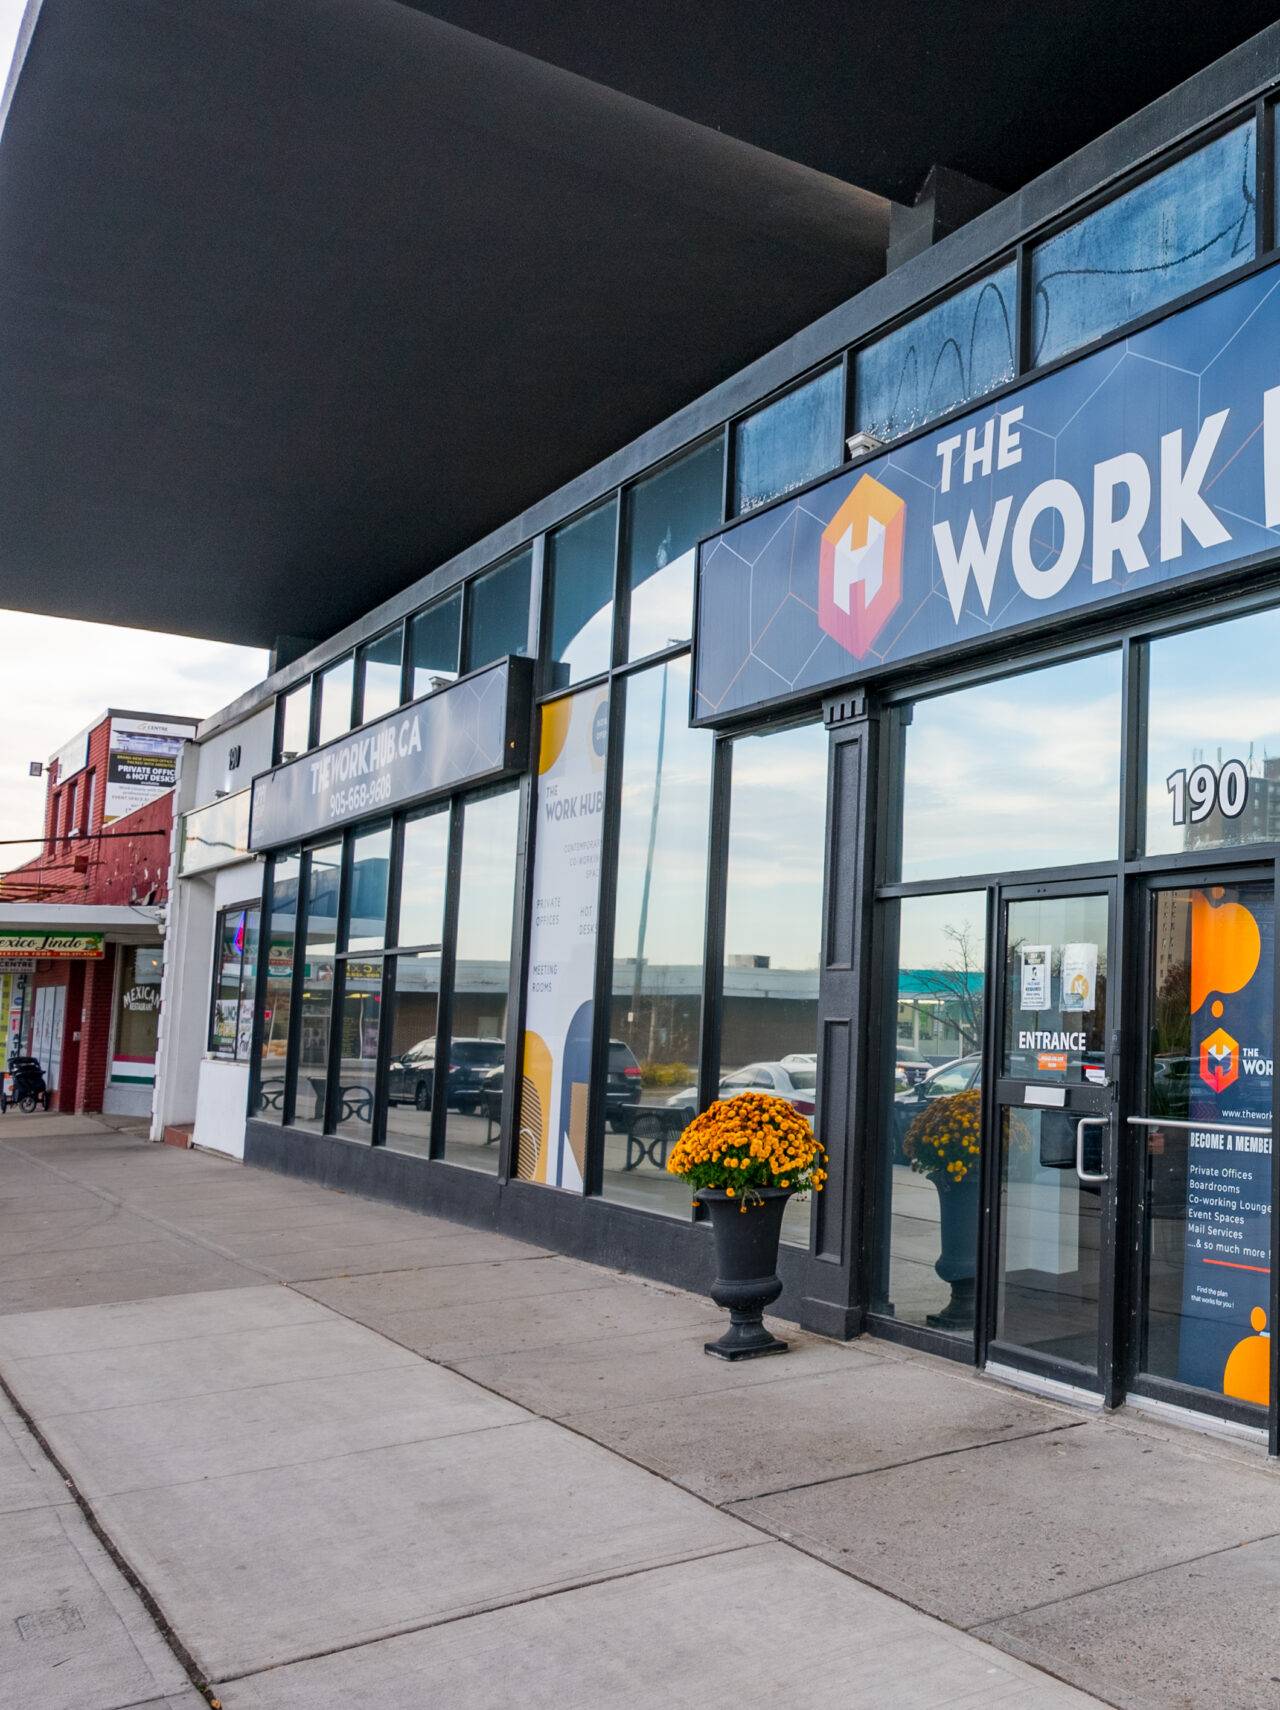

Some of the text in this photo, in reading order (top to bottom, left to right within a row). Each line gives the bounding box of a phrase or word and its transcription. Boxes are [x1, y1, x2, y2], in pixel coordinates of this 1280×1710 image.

[935, 405, 1025, 494] THE
[933, 408, 1233, 626] WORK
[118, 765, 176, 776] PRIVATE OFFIC
[132, 773, 150, 781] HOT
[150, 774, 175, 783] DESKS
[329, 776, 391, 817] 905-668-9608
[546, 785, 558, 798] THE
[1166, 759, 1249, 826] 190
[545, 790, 604, 821] WORK HUB
[586, 868, 600, 879] SPAC
[537, 897, 561, 909] PRIVATE
[580, 906, 592, 917] HOT
[536, 915, 560, 926] OFFICES
[0, 934, 82, 950] exico Lindo
[533, 964, 558, 976] MEETING
[532, 982, 552, 993] ROOMS
[123, 985, 161, 1009] MEXICAN
[1018, 1030, 1087, 1051] ENTRANCE
[1242, 1047, 1259, 1057] THE
[1242, 1059, 1273, 1076] WOR
[1190, 1132, 1225, 1150] BECOME
[1226, 1134, 1233, 1151] A
[1190, 1165, 1253, 1180] Private Offices
[1189, 1179, 1240, 1194] Boardrooms
[1188, 1194, 1272, 1214] Co-working Lounge
[1188, 1208, 1245, 1225] Event Spaces
[1188, 1223, 1243, 1240] Mail Services
[1203, 1242, 1214, 1250] so
[1216, 1242, 1240, 1255] much
[1243, 1248, 1266, 1259] more
[1196, 1285, 1207, 1294] Find
[1207, 1287, 1216, 1296] the
[1222, 1301, 1232, 1309] you
